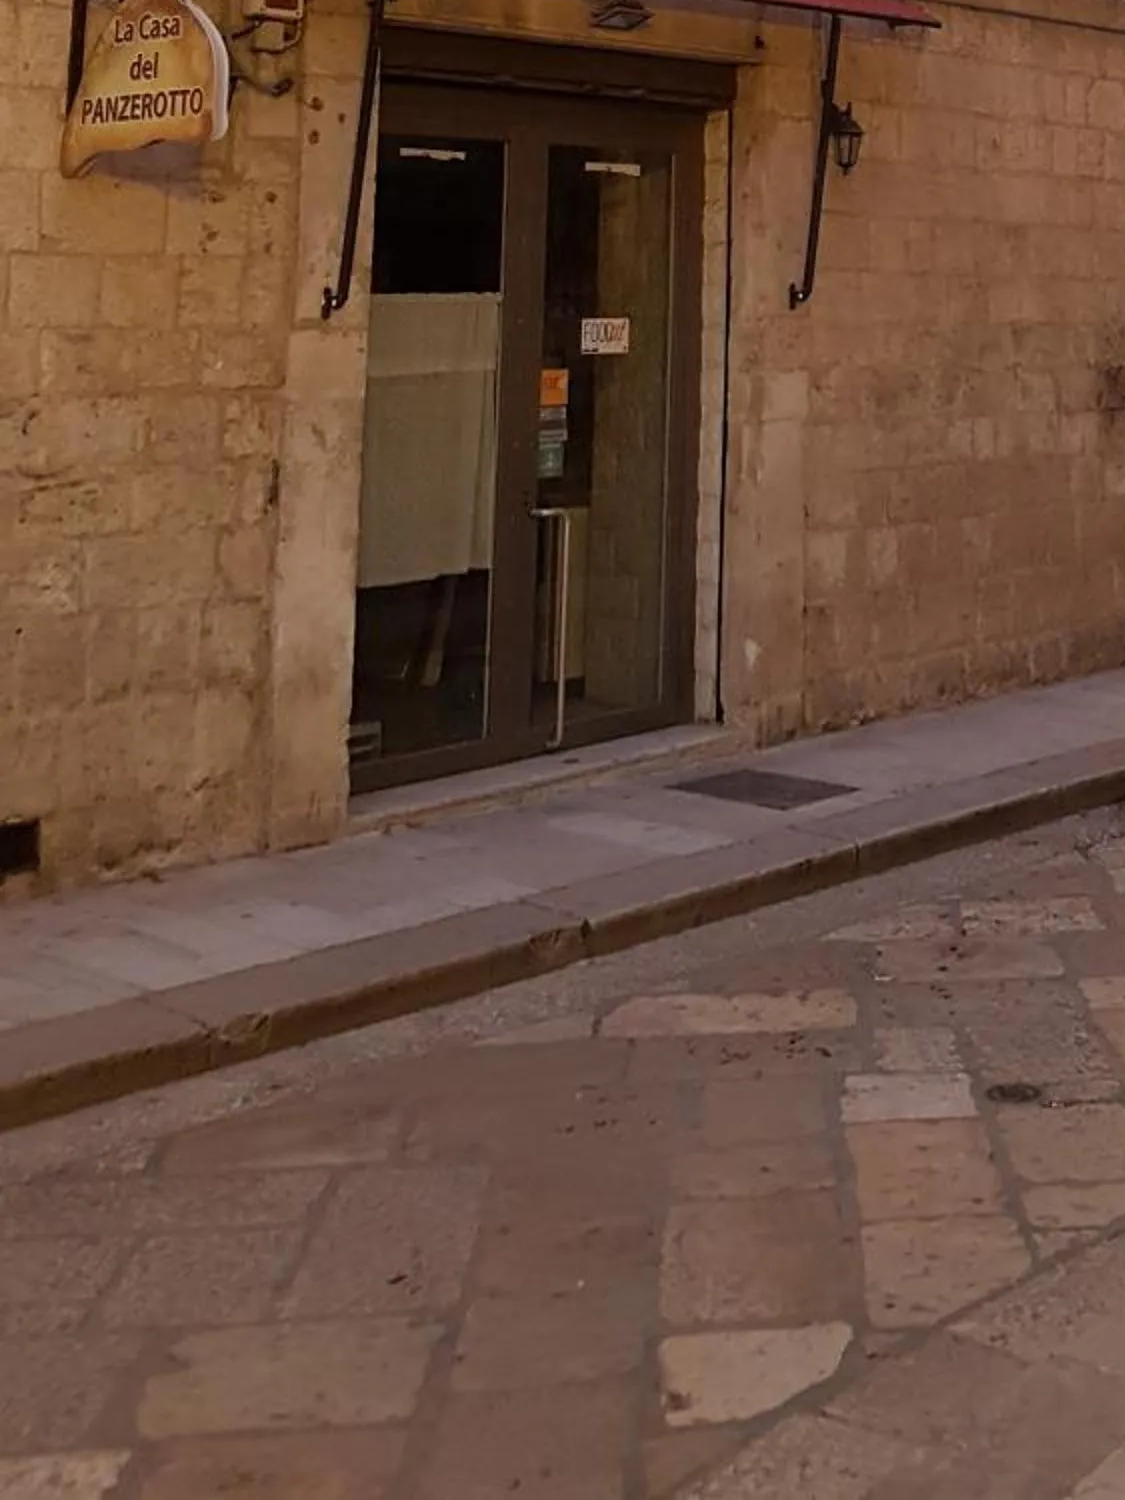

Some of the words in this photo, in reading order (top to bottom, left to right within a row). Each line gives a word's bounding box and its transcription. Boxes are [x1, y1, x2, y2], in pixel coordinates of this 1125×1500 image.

[114, 18, 134, 43] La
[138, 14, 181, 41] Casa
[129, 51, 159, 81] del
[81, 87, 204, 125] PANZEROTTO
